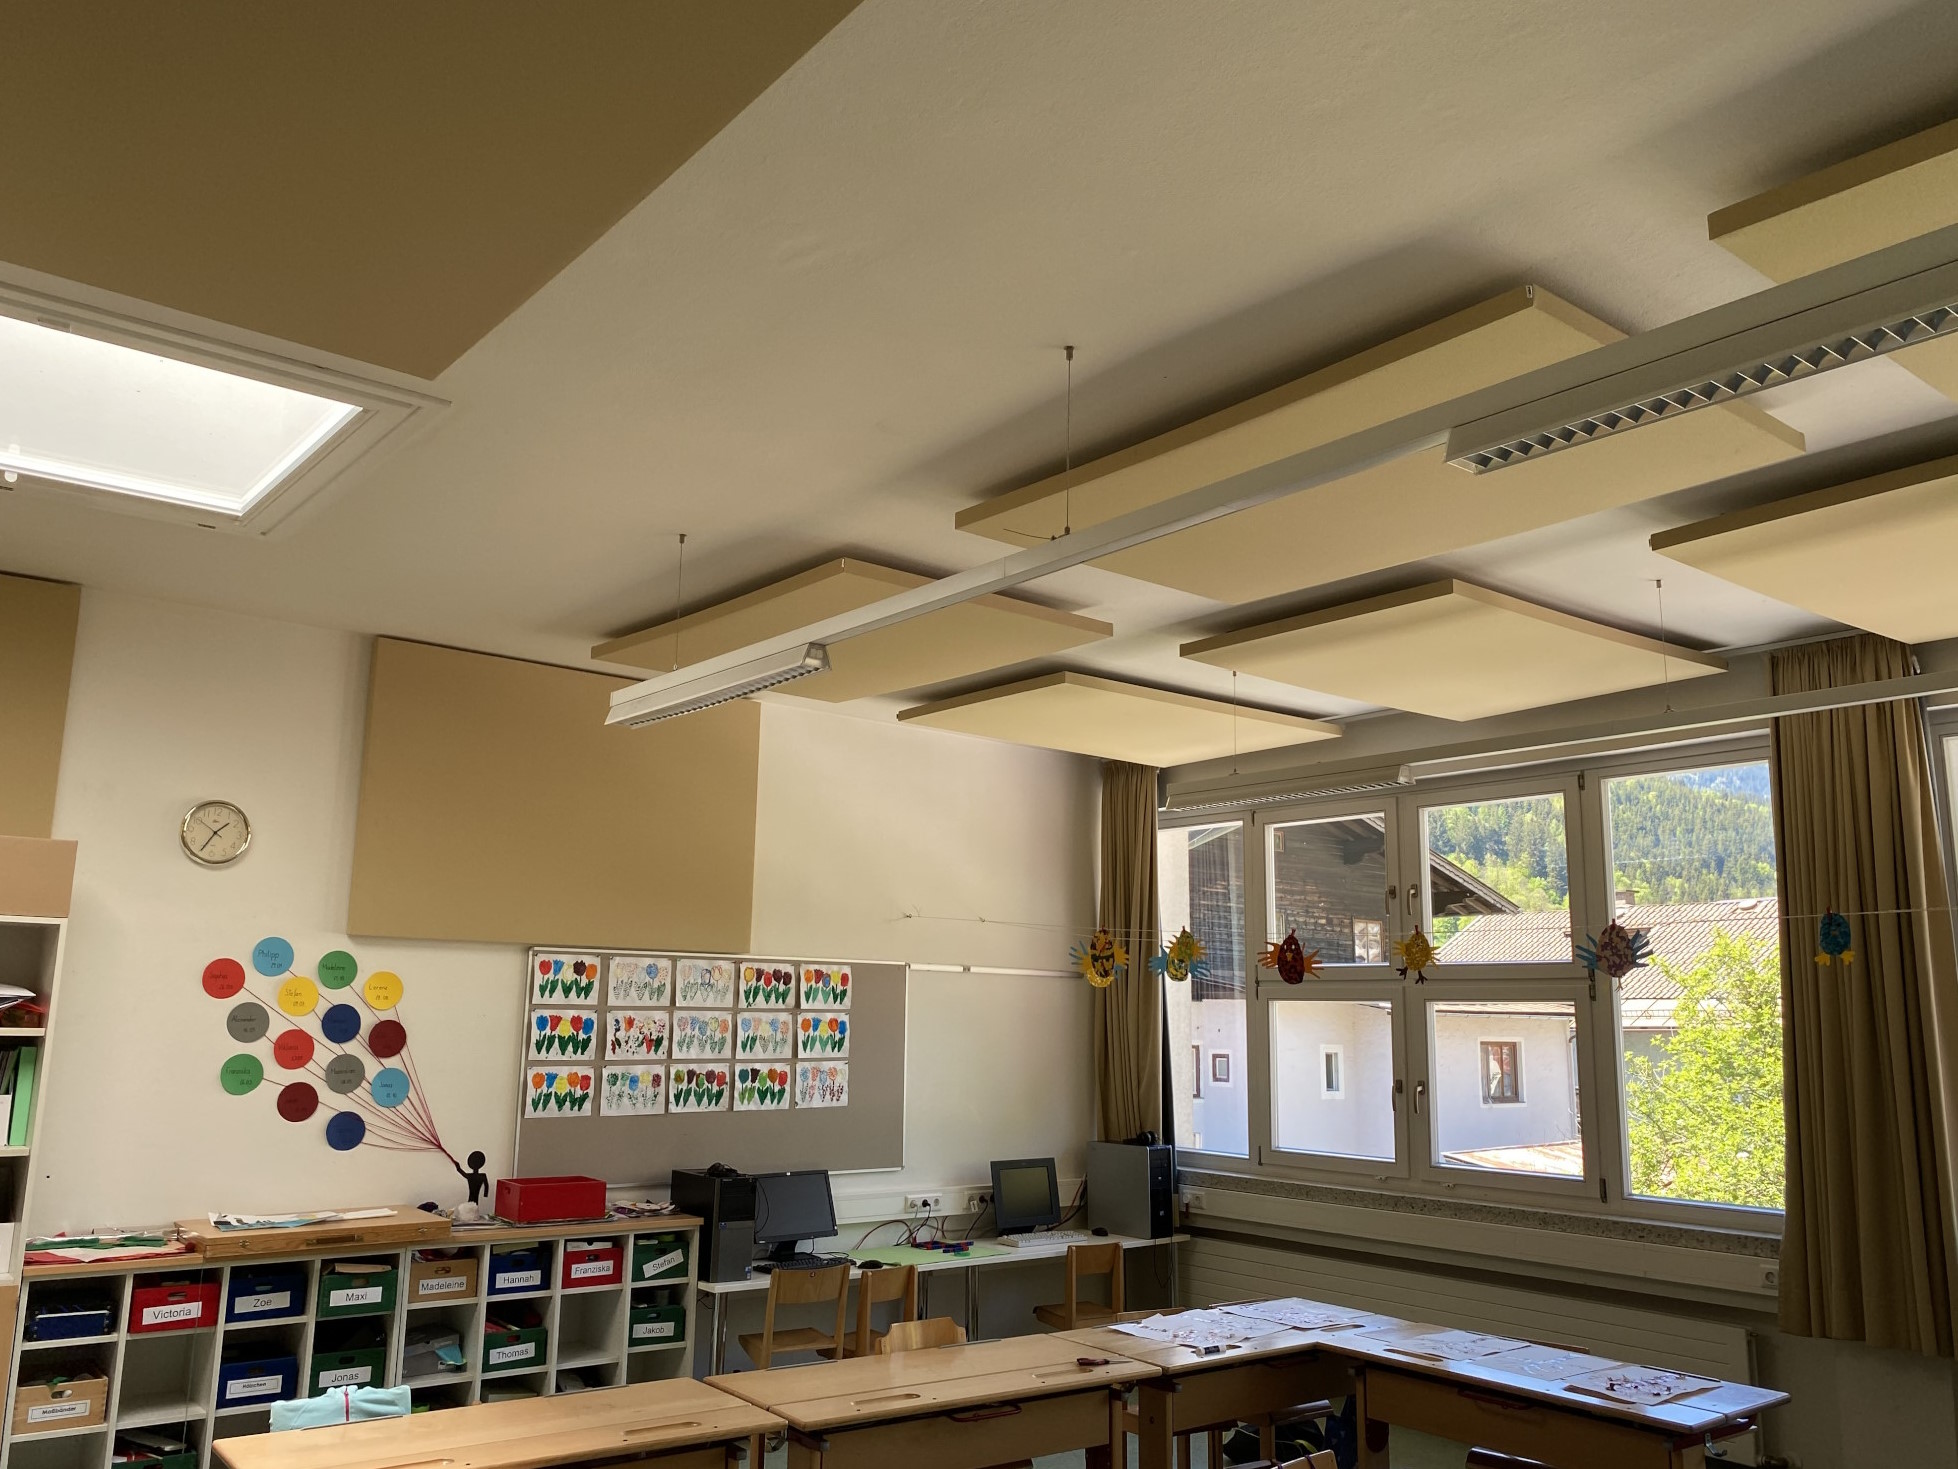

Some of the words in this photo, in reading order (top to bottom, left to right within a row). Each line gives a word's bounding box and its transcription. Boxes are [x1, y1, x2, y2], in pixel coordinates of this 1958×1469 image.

[574, 1264, 611, 1275] Franziska
[652, 1257, 675, 1271] Stefan
[503, 1275, 534, 1285] Hannah
[421, 1281, 465, 1292] Madeleine
[345, 1292, 367, 1301] Maxi
[253, 1298, 272, 1308] Zoe
[153, 1307, 192, 1320] Victoria
[642, 1326, 665, 1335] Jakob
[496, 1348, 529, 1359] Thomas
[331, 1372, 359, 1383] Jonas
